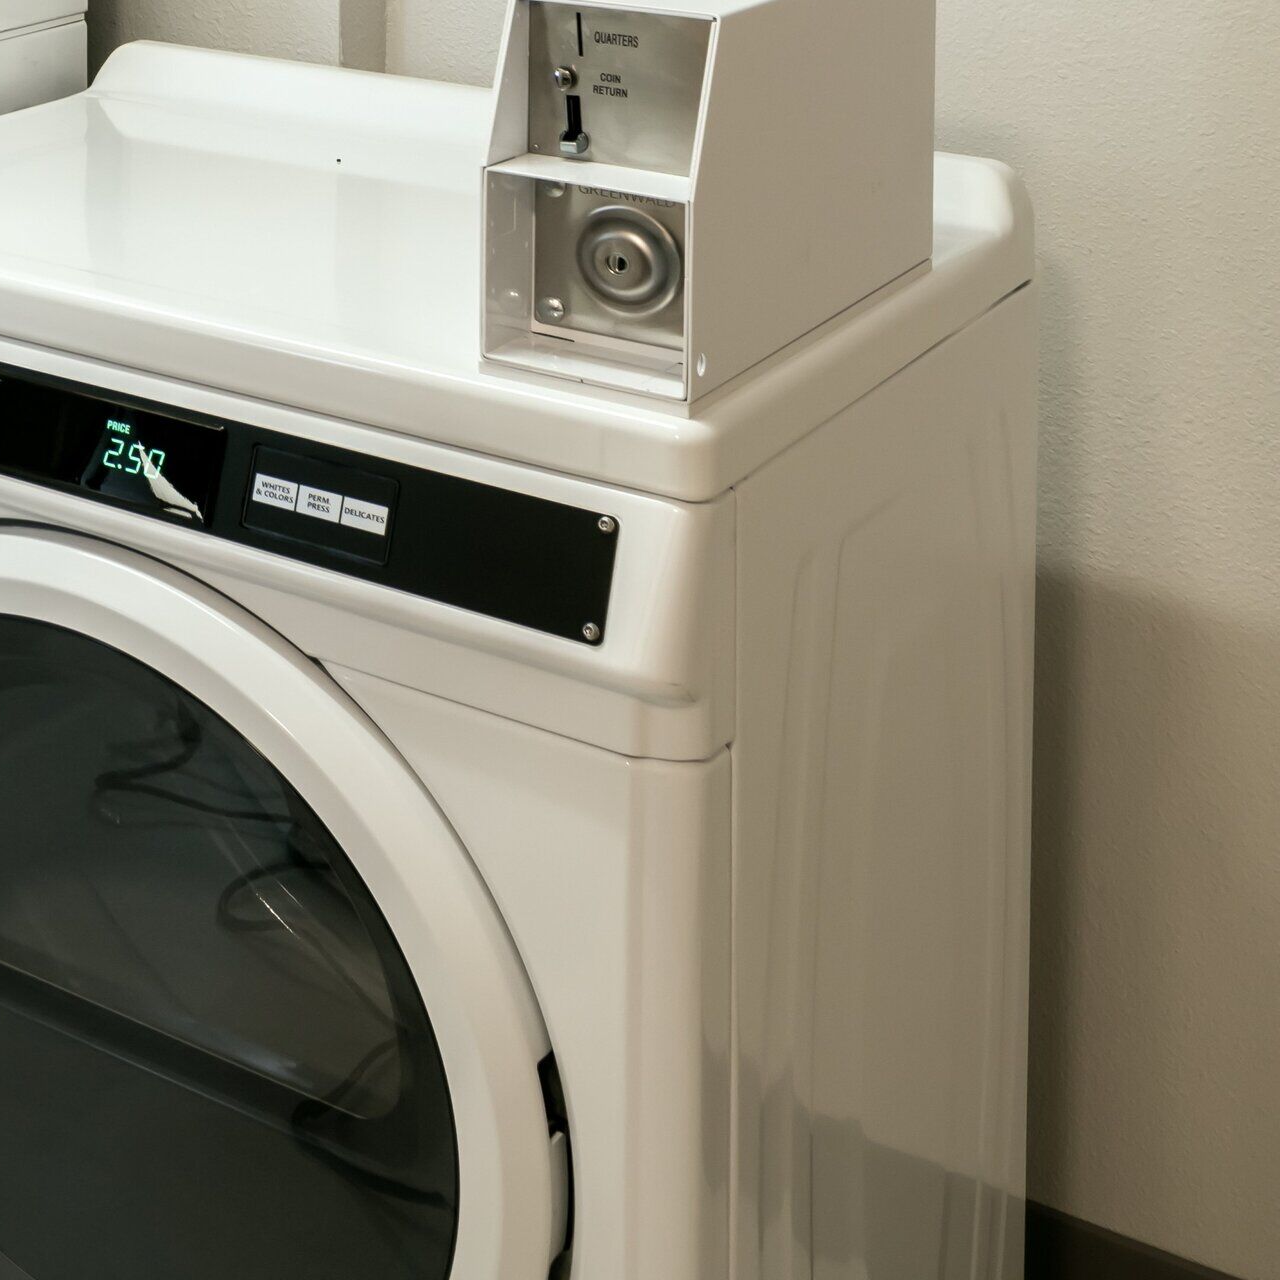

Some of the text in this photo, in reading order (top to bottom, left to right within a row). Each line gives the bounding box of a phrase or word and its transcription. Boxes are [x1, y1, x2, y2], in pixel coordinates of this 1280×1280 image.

[594, 30, 640, 48] QUARTERS
[600, 72, 622, 84] COIN
[592, 84, 629, 99] RETURN
[106, 419, 131, 434] PRICE
[103, 437, 166, 479] 2.50
[261, 480, 291, 494] WHITES
[255, 487, 294, 504] & COLORS
[307, 501, 330, 513] PRESS
[344, 507, 385, 524] DELICATES
